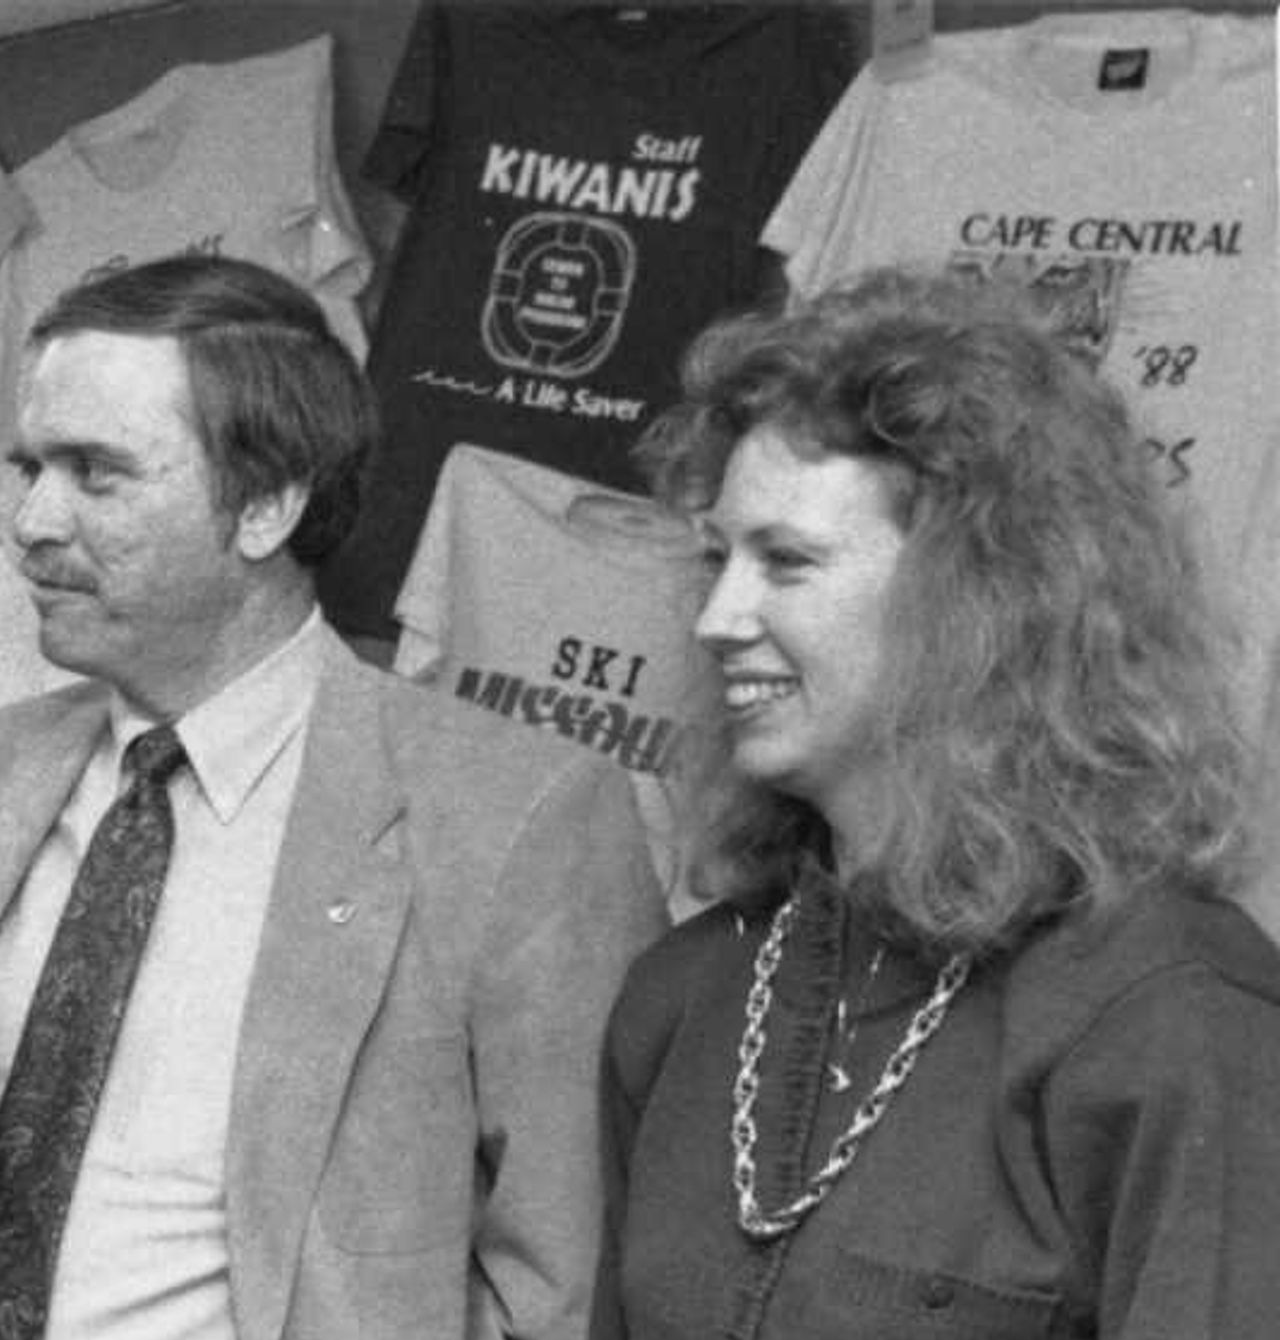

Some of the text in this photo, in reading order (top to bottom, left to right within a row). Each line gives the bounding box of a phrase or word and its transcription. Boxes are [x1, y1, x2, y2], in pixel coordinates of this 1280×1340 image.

[631, 134, 704, 163] Staff
[479, 143, 701, 222] KIWANIS
[959, 213, 1243, 256] CAPE CENTRAL
[1133, 345, 1200, 388] '88
[493, 376, 646, 422] A Life Saver
[551, 635, 646, 697] SKI
